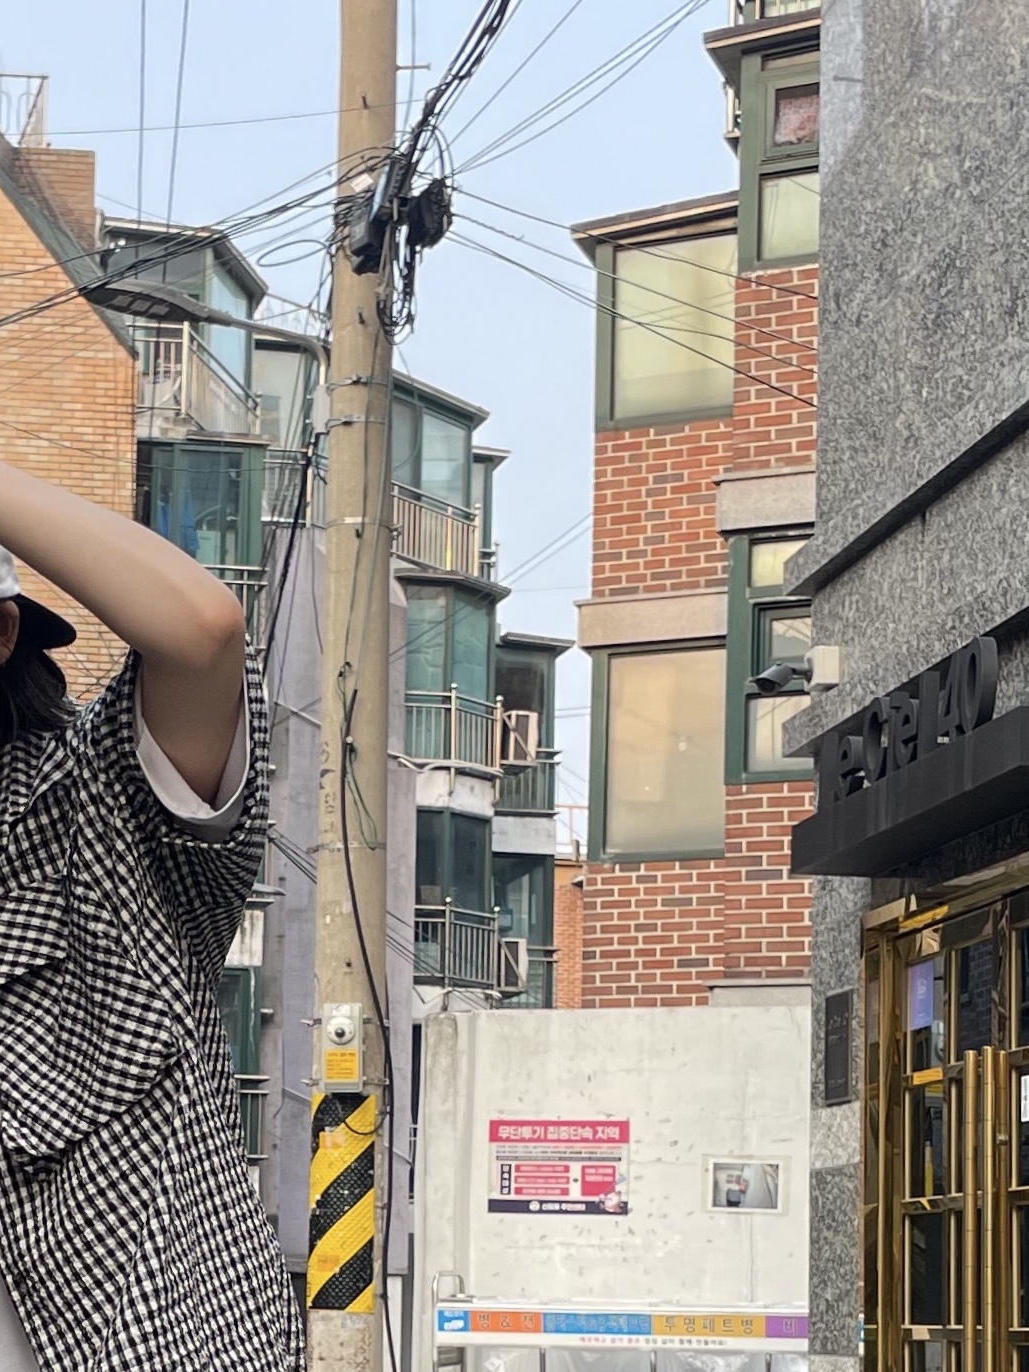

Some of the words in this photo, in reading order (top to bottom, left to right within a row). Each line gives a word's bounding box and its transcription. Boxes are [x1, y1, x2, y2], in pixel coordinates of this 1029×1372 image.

[937, 636, 998, 743] 40
[497, 1125, 544, 1140] 무단투기
[546, 1125, 593, 1140] 집중단속
[595, 1126, 620, 1140] 지역
[478, 1313, 490, 1329] 병
[500, 1315, 512, 1329] &
